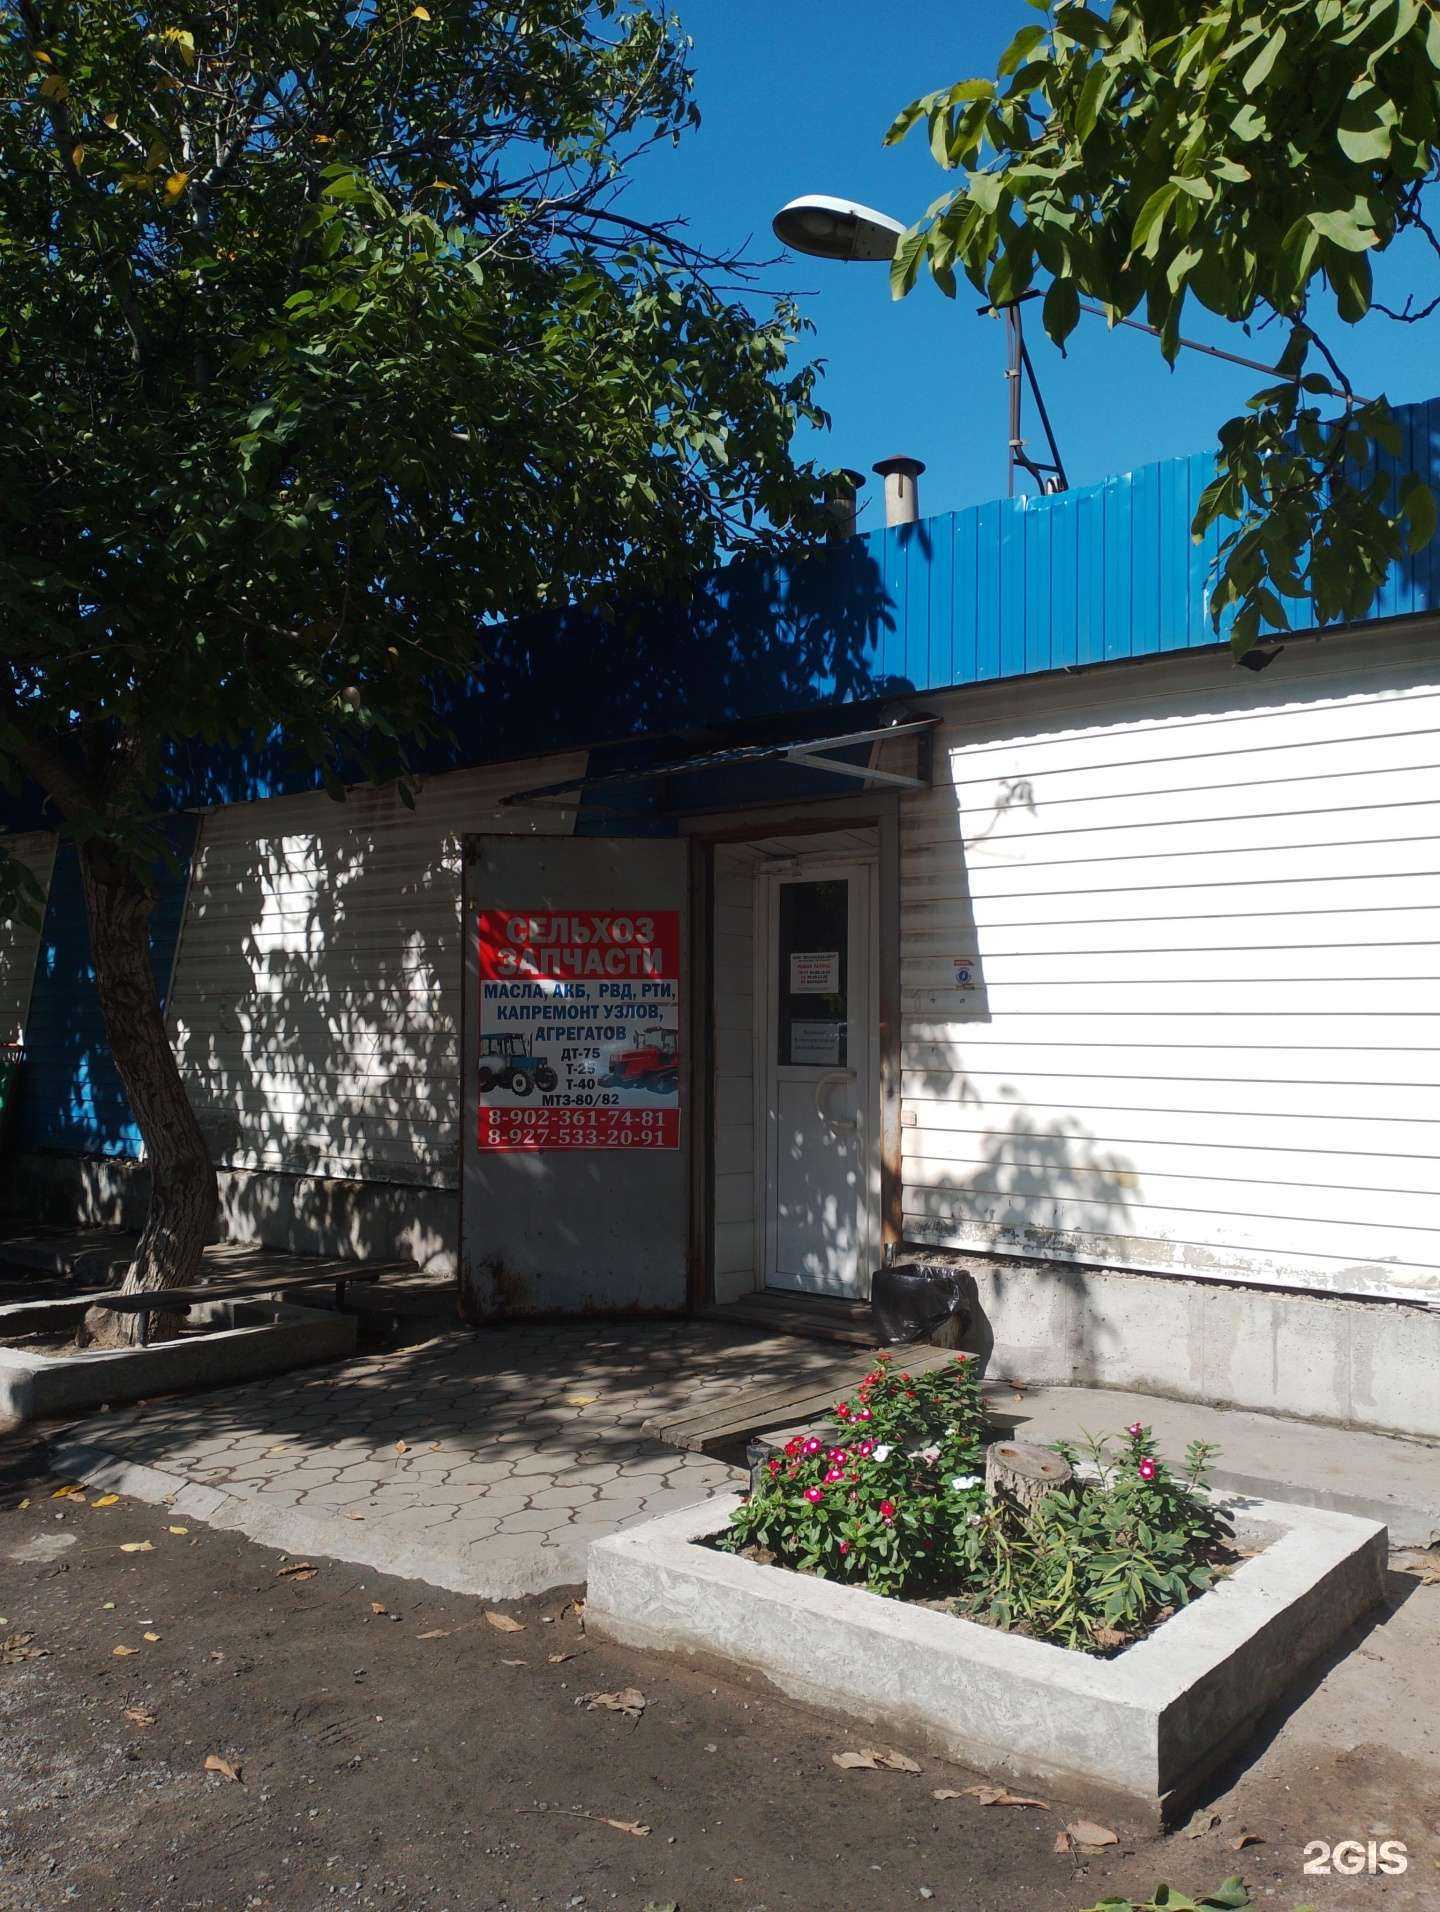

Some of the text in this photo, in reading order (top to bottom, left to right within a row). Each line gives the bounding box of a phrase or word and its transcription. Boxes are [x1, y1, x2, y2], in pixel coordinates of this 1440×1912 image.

[506, 917, 655, 944] СЕЛЬХОЗ
[497, 947, 663, 975] ЗАПЧАСТИ
[484, 983, 676, 1000] МАСЛА, АКБ, РВД, РТИ,
[497, 1004, 663, 1022] КАПРЕМОНТ УЗЛОВ,
[535, 1026, 626, 1041] АГРЕГАТОВ
[561, 1048, 601, 1062] ДТ-75
[566, 1063, 596, 1075] Т-25
[566, 1079, 596, 1090] Т-40
[542, 1094, 620, 1107] МТЗ-80/82
[488, 1110, 665, 1127] 8-902-361-74-81
[488, 1129, 665, 1145] 8-927-533-20-91
